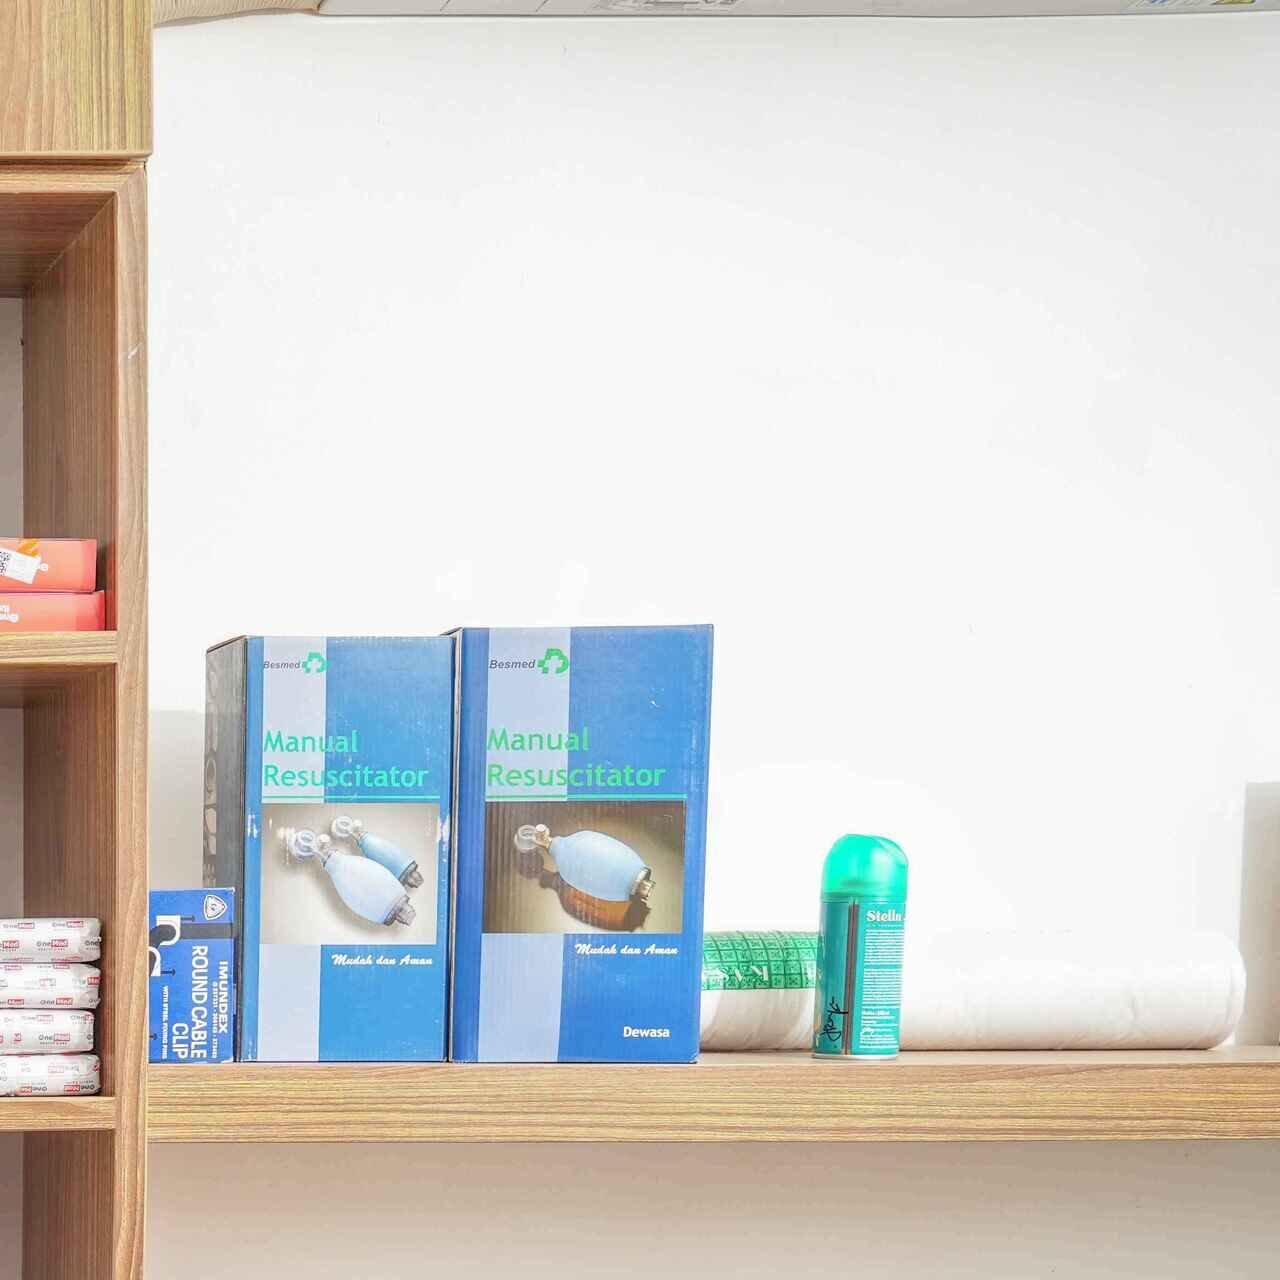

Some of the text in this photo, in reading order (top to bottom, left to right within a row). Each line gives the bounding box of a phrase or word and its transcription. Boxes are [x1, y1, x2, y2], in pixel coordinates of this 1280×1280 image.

[263, 659, 301, 671] Besmed
[489, 658, 536, 671] Besmed
[263, 730, 359, 755] Manual
[486, 726, 590, 752] Manual
[263, 764, 429, 789] Resuscitator
[486, 763, 667, 788] Resuscitator
[37, 939, 69, 947] OneMed
[574, 943, 679, 957] Mudah dan Aman
[331, 954, 434, 967] Mudah dan Aman
[192, 945, 208, 1058] ROUND CABLE
[219, 961, 228, 1034] IMUNDEX
[172, 1023, 188, 1058] CLIP
[622, 1025, 671, 1040] Dewasa
